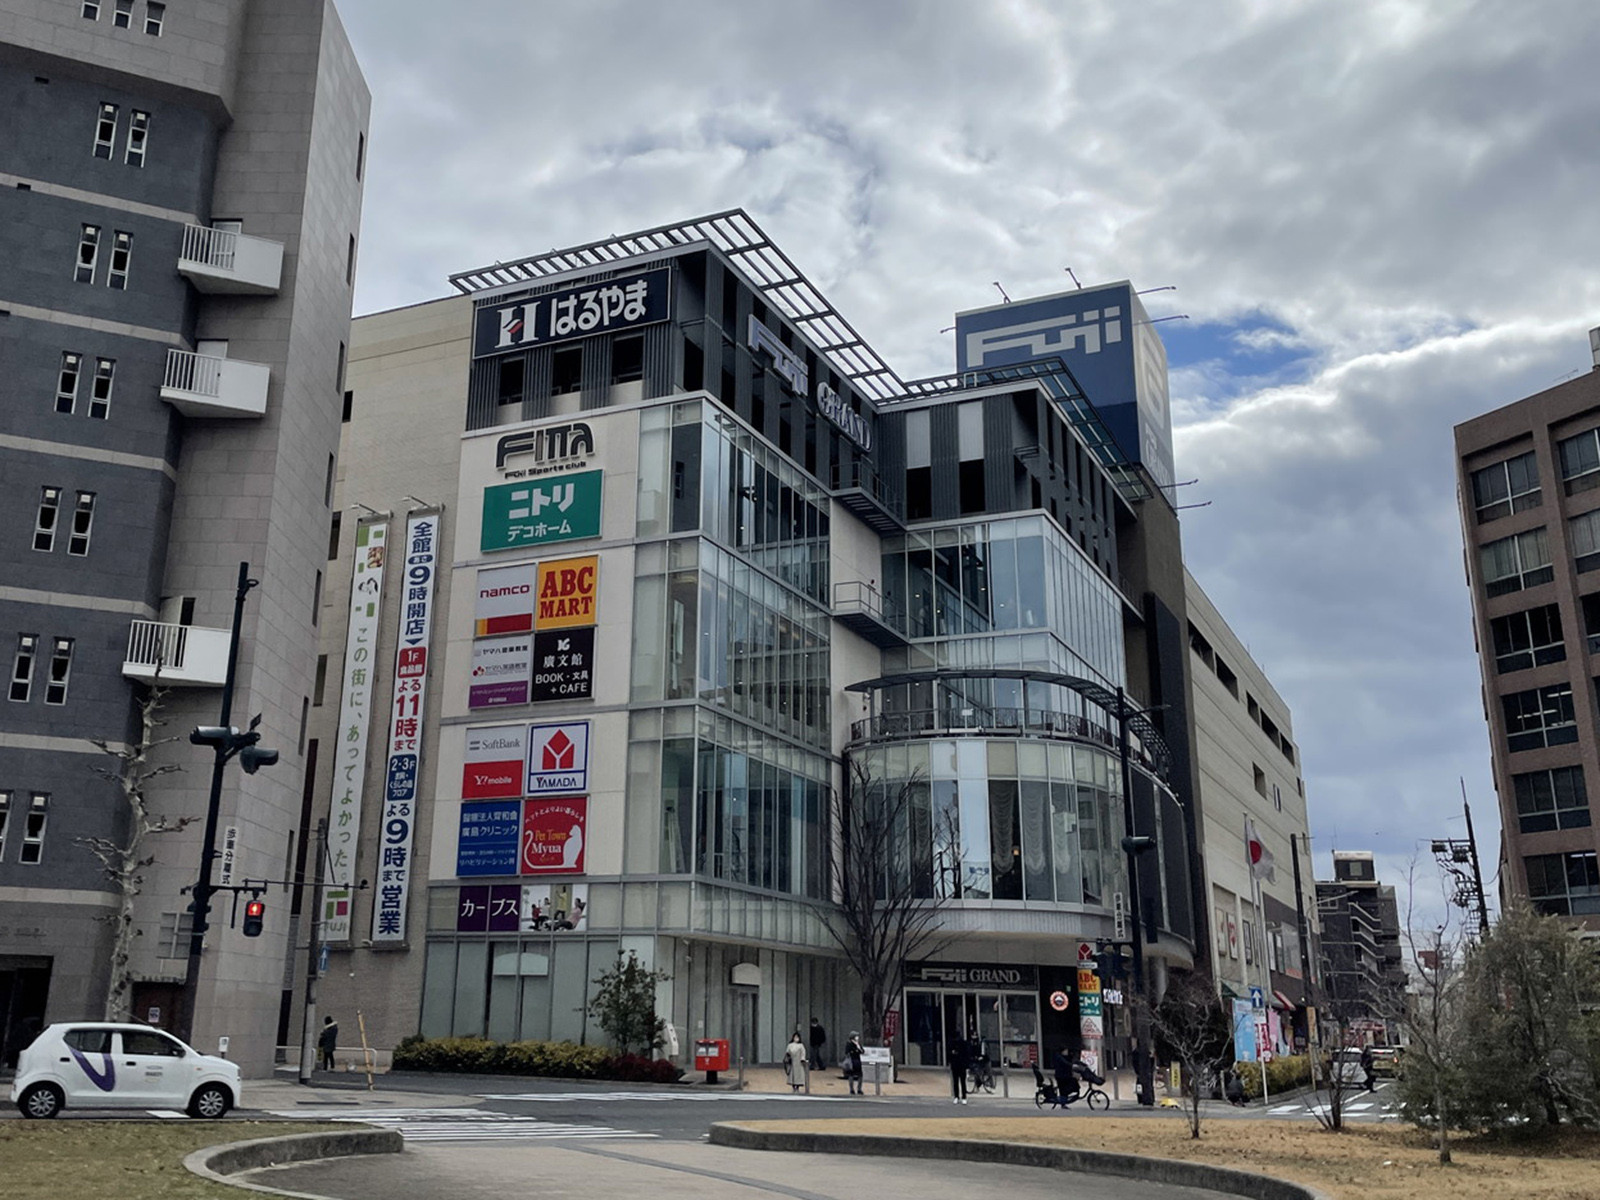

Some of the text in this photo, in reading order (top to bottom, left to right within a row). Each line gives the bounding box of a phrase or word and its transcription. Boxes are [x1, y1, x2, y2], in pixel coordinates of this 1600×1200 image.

[550, 279, 647, 337] はるやま
[528, 464, 564, 476] Sports
[565, 461, 587, 470] club
[509, 483, 574, 519] ニトリ
[507, 519, 572, 542] デコホーム
[540, 566, 593, 598] ABC
[480, 584, 530, 598] namco
[539, 596, 592, 619] MART
[408, 650, 420, 662] 1F
[559, 682, 587, 694] CAFE
[481, 738, 520, 750] SoftBank
[536, 777, 577, 788] YAMADA
[969, 968, 1020, 983] GRAND
[1079, 995, 1100, 1007] ニトリ
